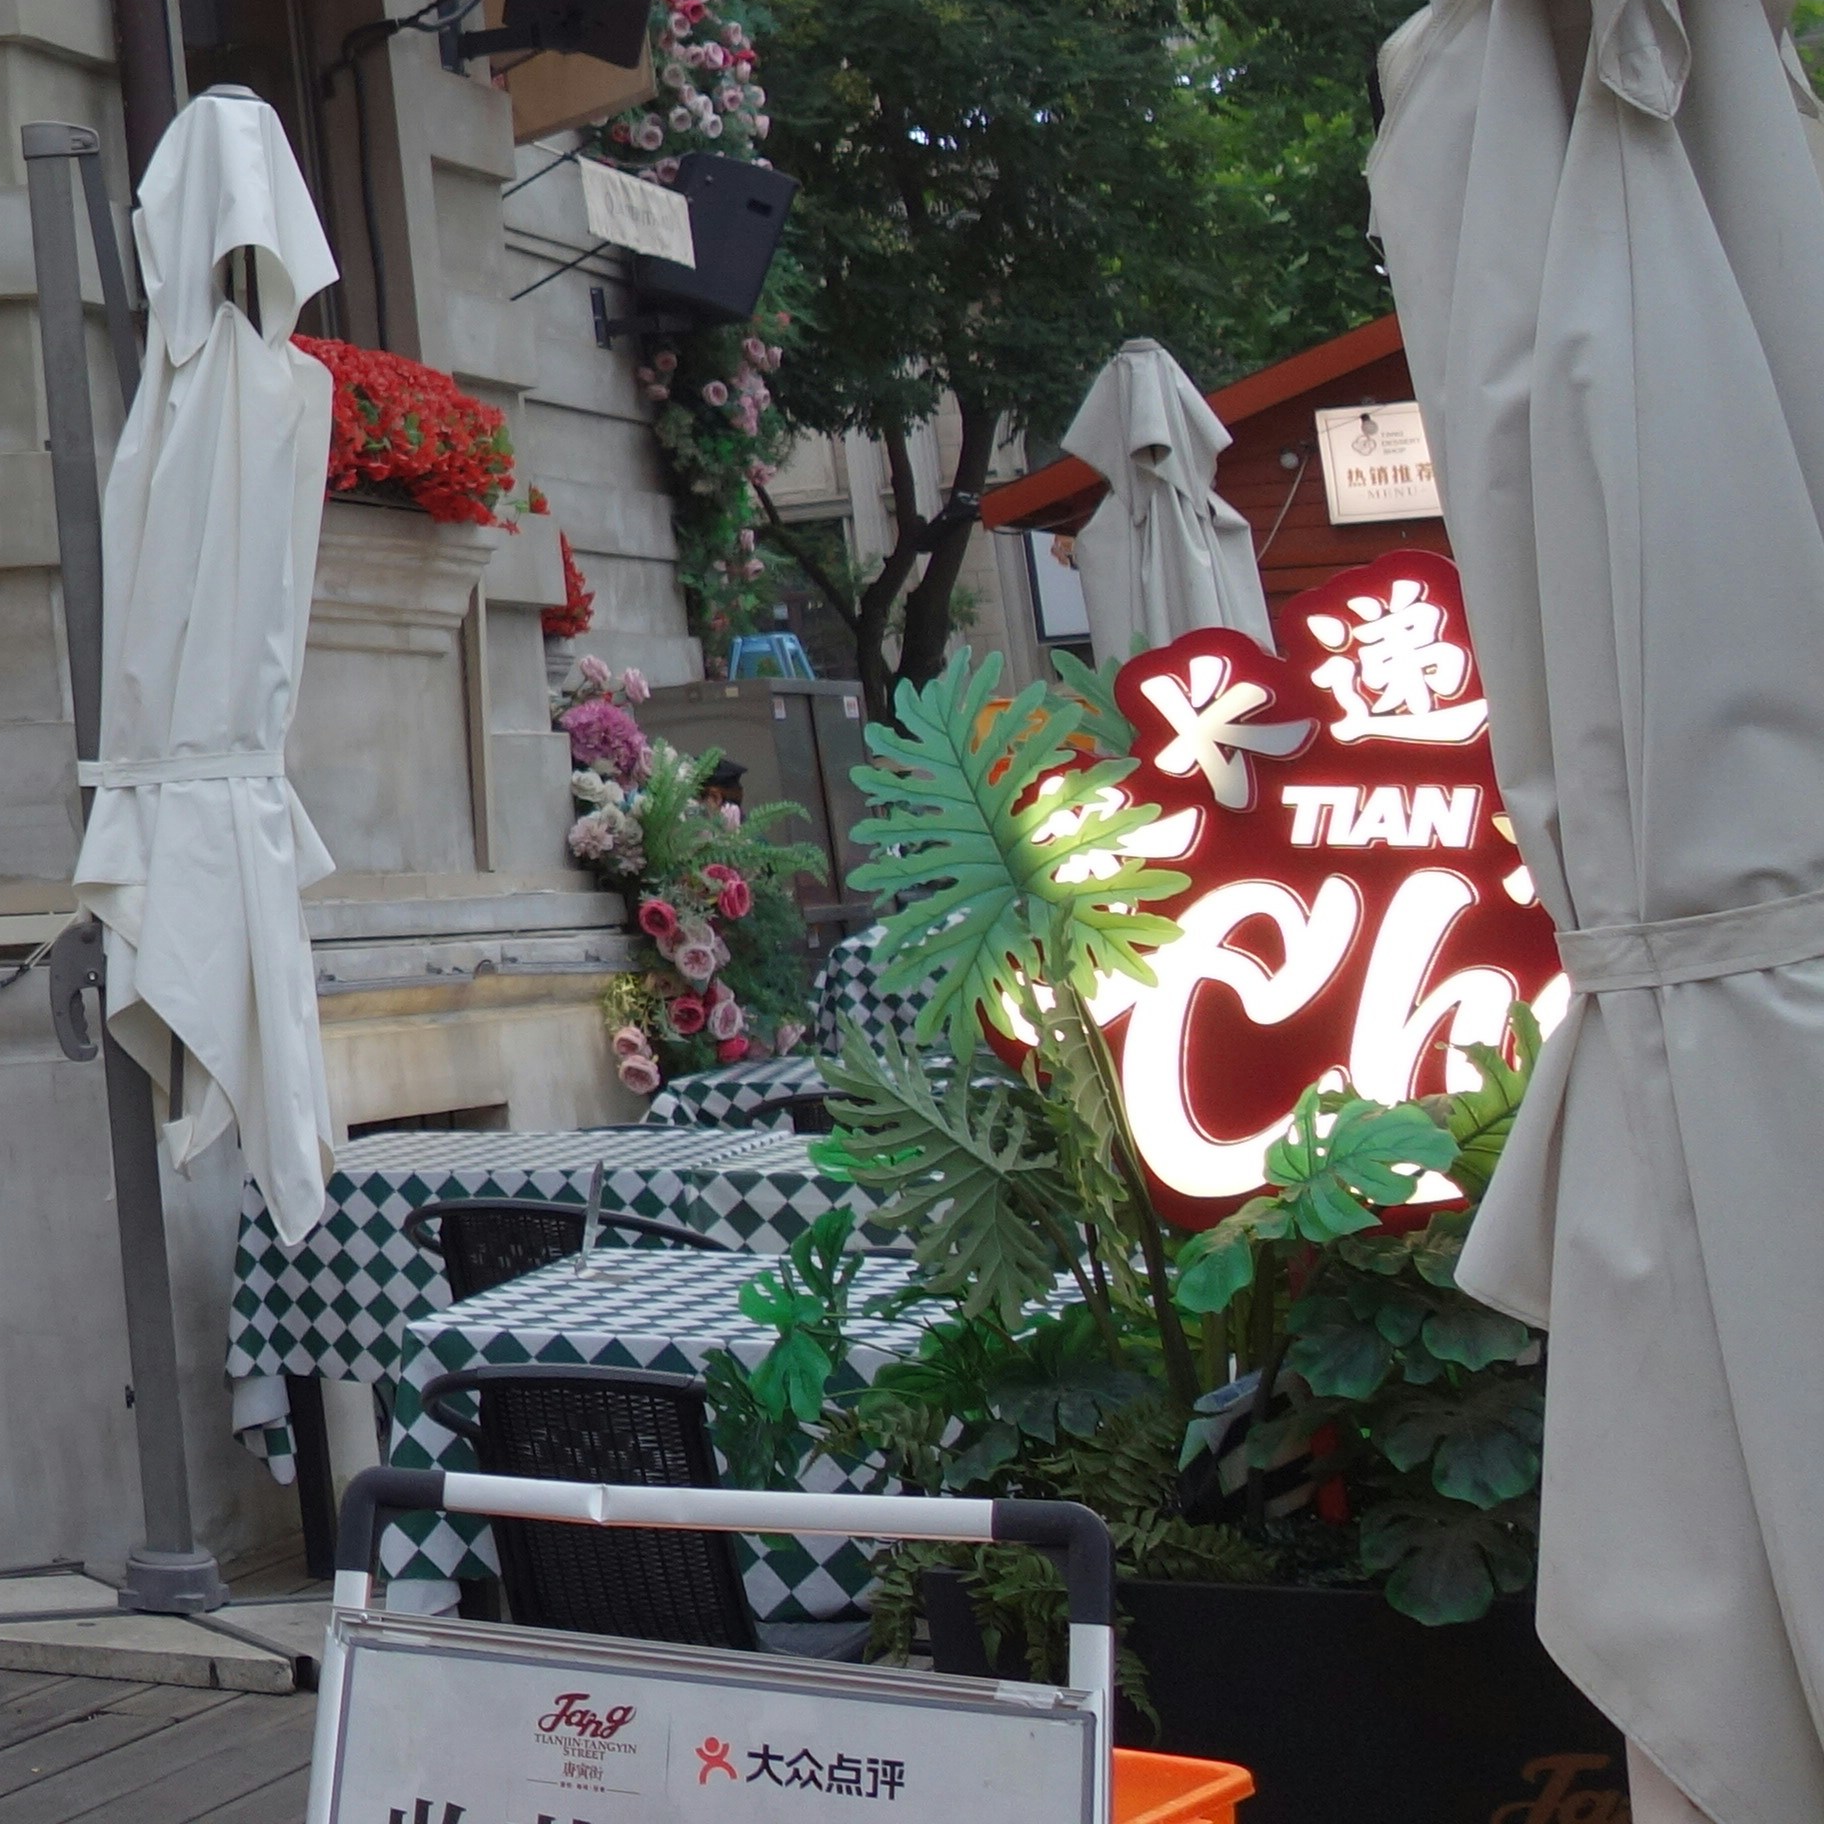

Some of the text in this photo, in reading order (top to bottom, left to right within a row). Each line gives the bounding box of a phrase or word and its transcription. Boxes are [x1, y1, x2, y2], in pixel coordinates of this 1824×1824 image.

[1280, 784, 1479, 849] TIAN
[537, 1692, 638, 1740] Tang
[562, 1746, 606, 1762] STREET
[745, 1743, 906, 1802] 大众点评
